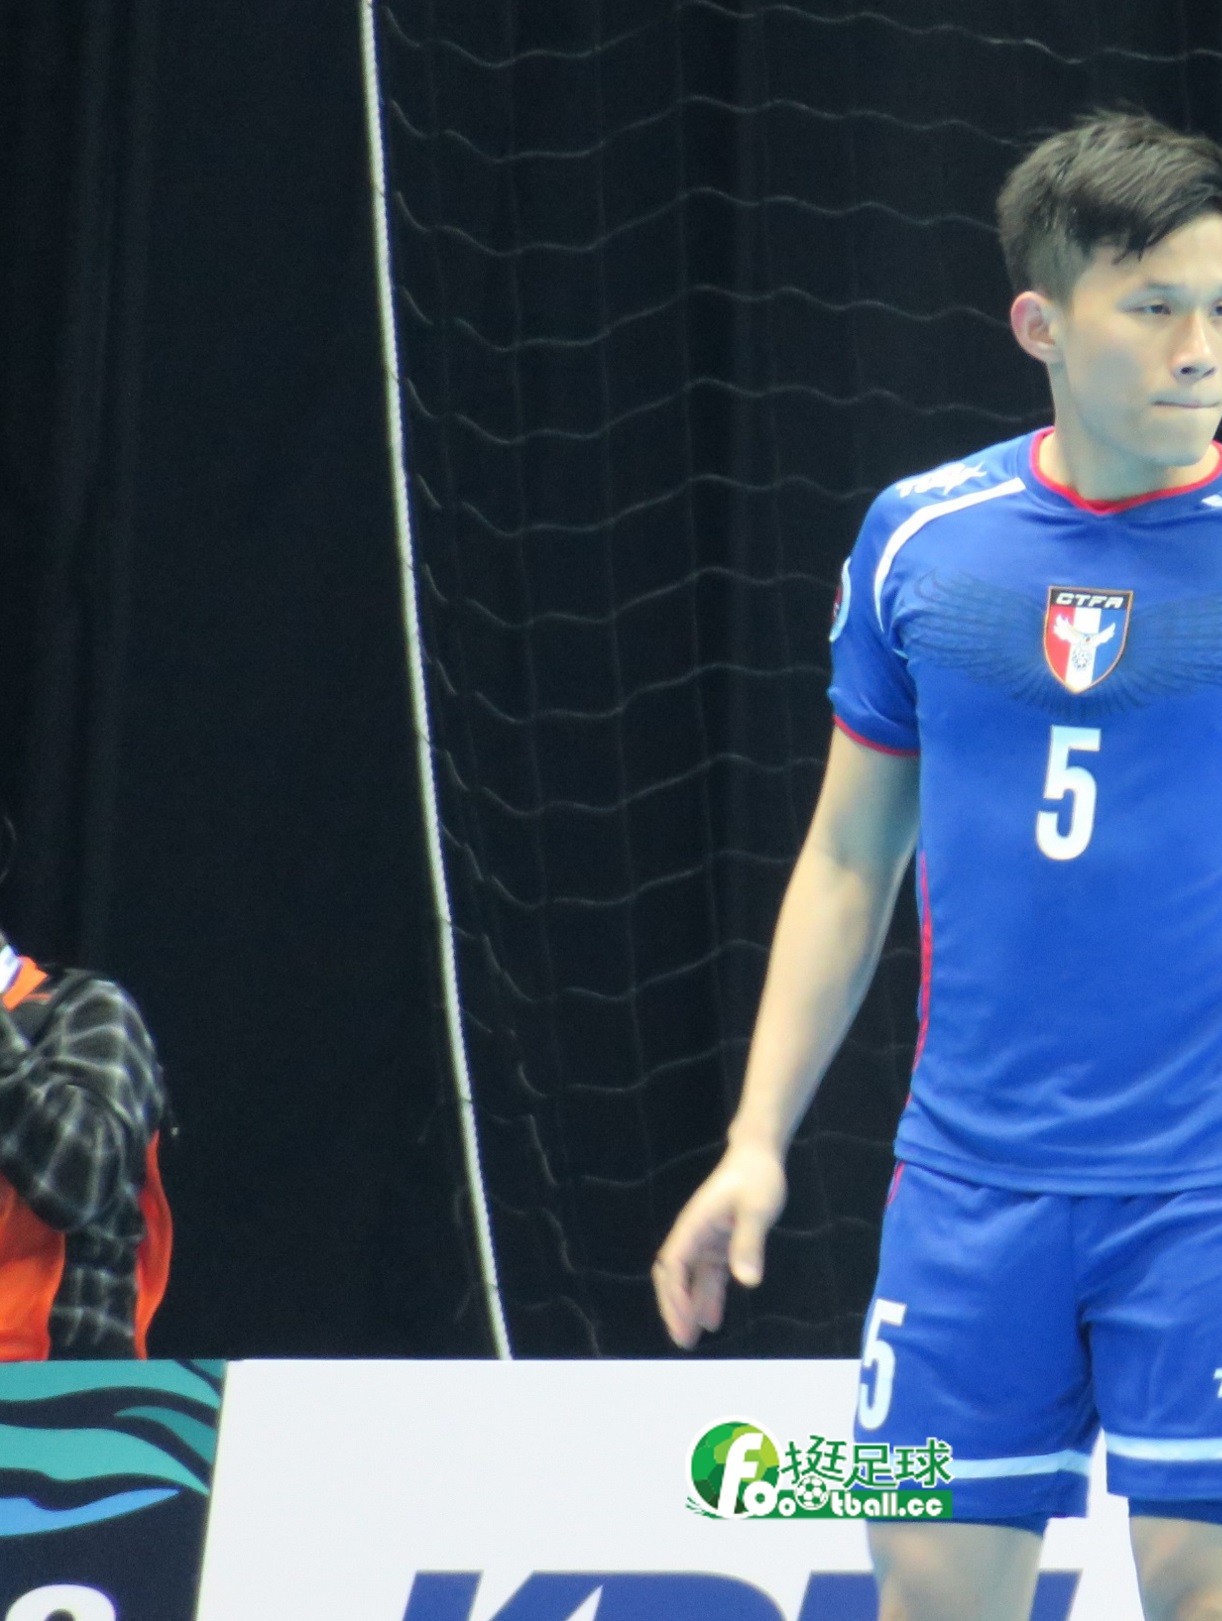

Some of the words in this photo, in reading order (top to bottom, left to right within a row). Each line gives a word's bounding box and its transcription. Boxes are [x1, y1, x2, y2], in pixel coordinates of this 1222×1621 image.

[1055, 592, 1124, 609] CTFA
[1036, 726, 1101, 861] 5
[859, 1298, 907, 1431] 5
